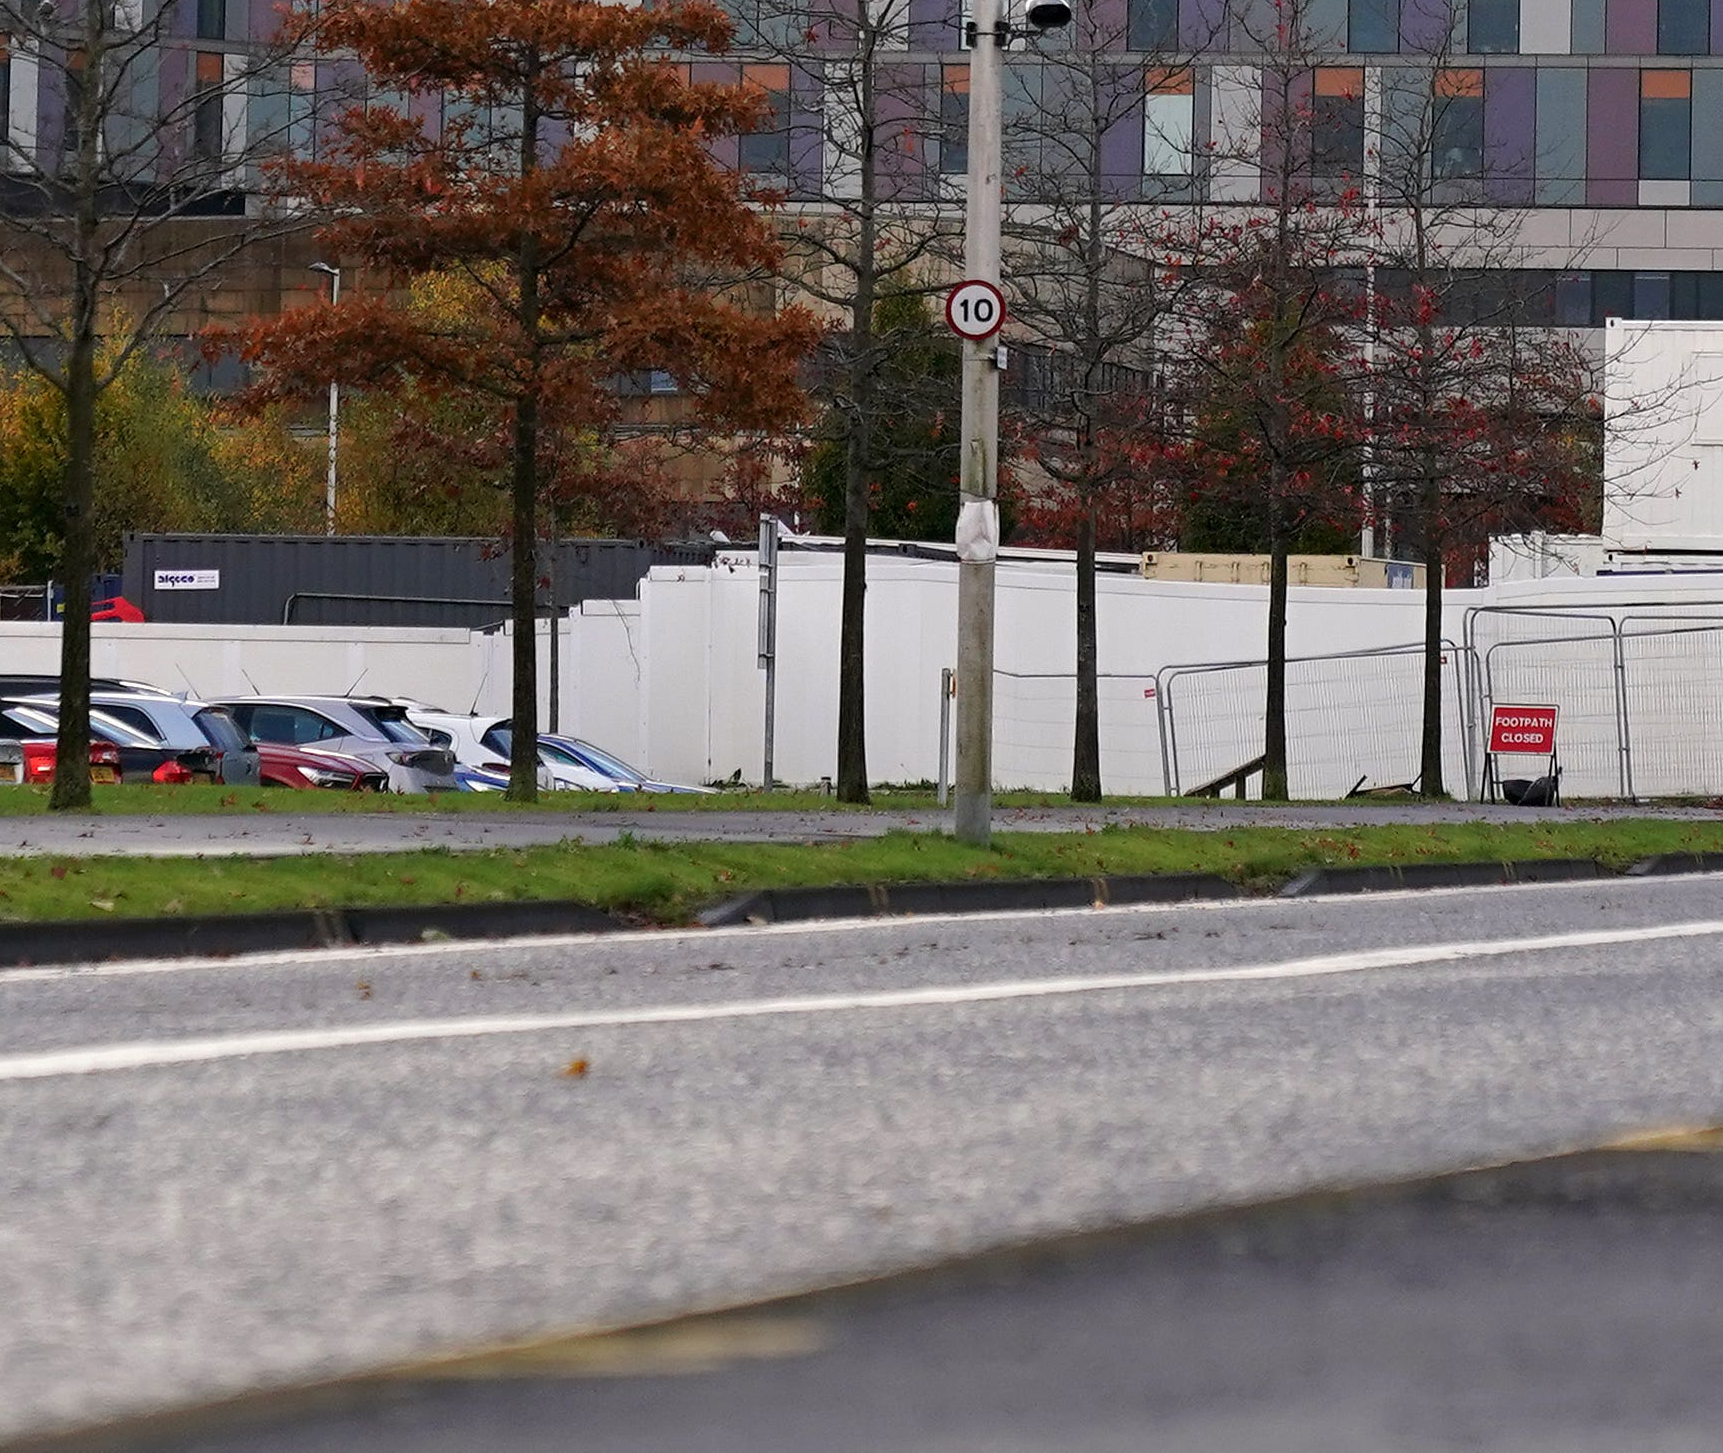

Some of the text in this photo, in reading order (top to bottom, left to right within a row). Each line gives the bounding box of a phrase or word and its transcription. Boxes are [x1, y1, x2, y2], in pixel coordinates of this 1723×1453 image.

[960, 299, 994, 323] 10
[1495, 716, 1553, 728] FOOTPATH
[1501, 732, 1544, 744] CLOSED
